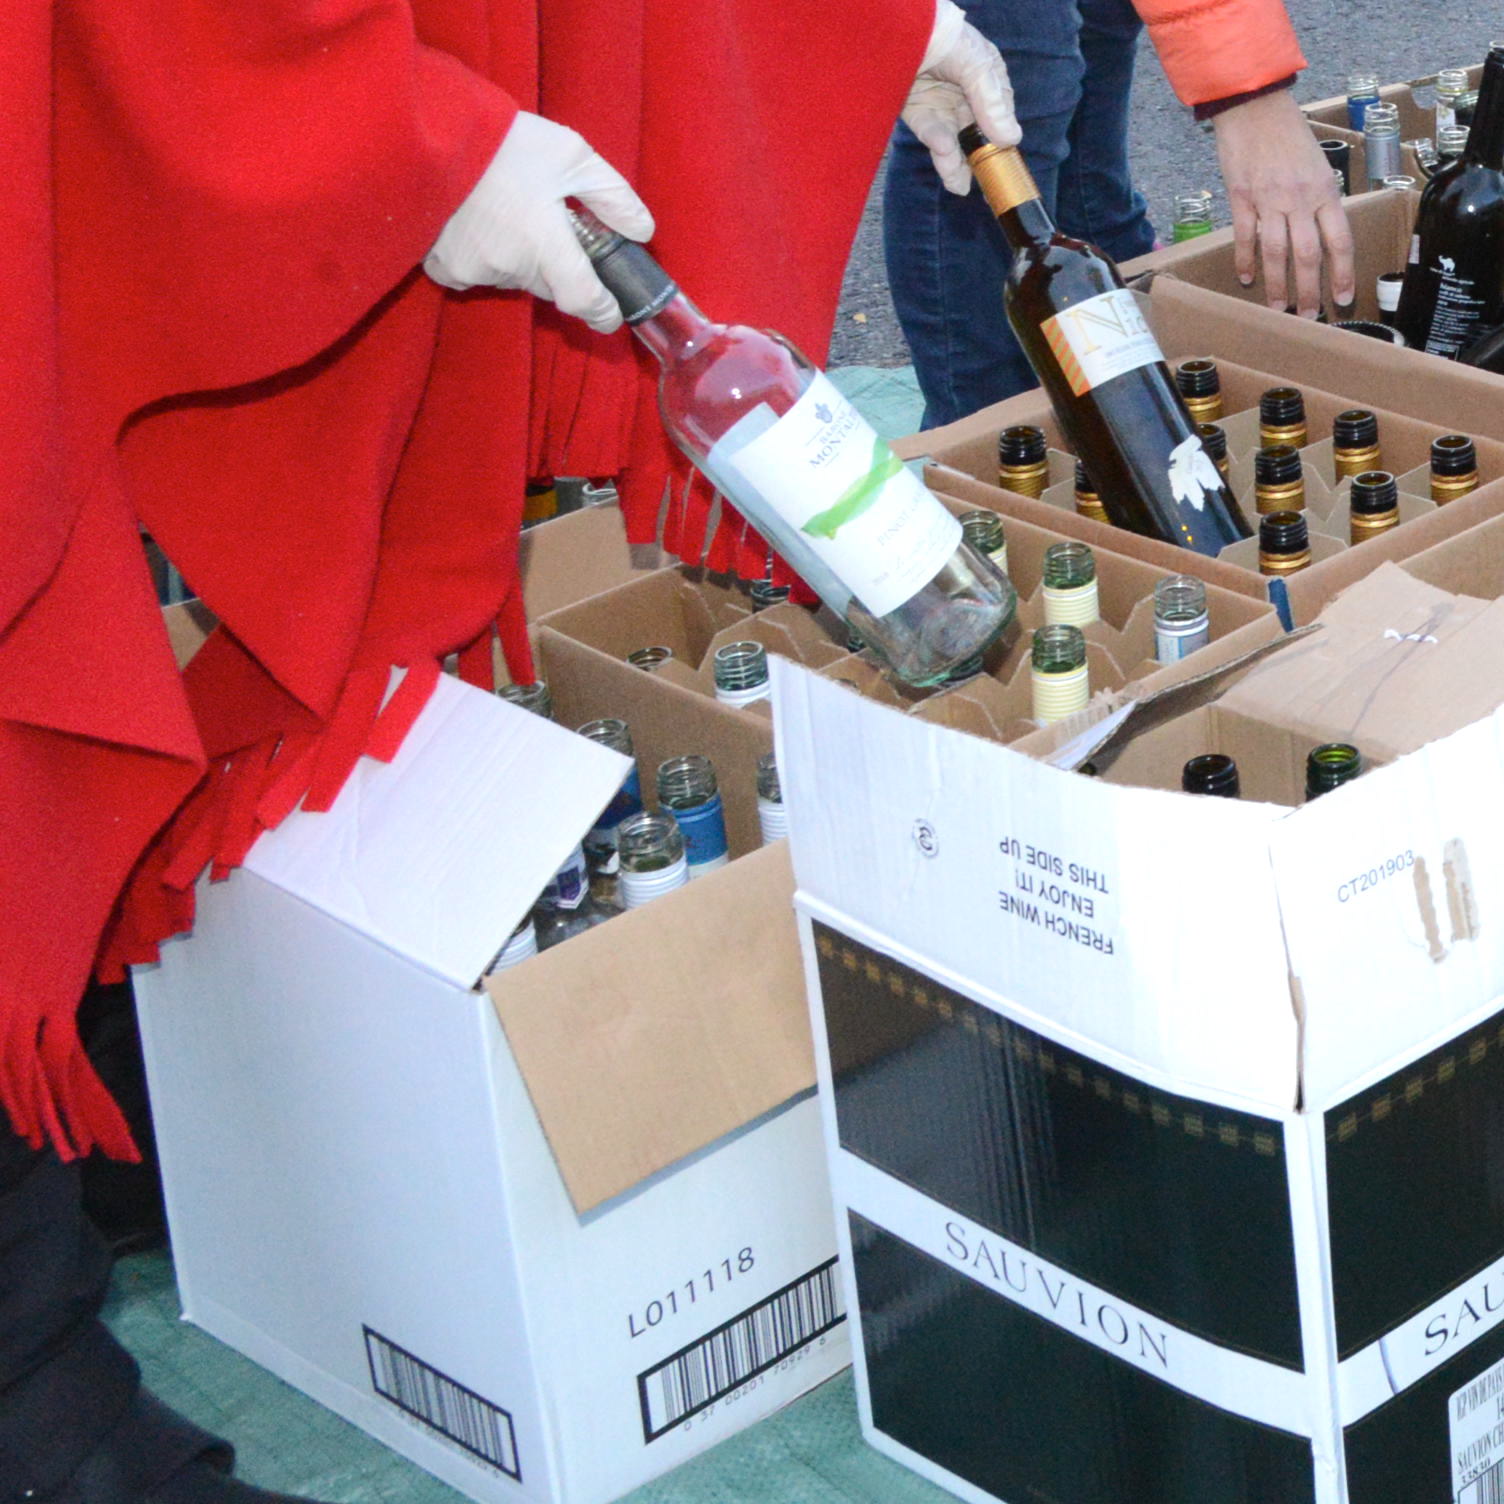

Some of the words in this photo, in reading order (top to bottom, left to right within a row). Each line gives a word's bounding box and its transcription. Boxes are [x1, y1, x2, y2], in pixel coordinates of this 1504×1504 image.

[999, 836, 1022, 857] UP
[1025, 844, 1064, 877] SIDE
[1014, 869, 1034, 893] IT!
[1069, 861, 1109, 894] THIS
[1336, 848, 1416, 904] CT201903
[999, 890, 1042, 929] WINE
[1038, 881, 1094, 917] ENJOY
[1046, 912, 1114, 956] FRENCH
[945, 1220, 1169, 1370] SAUVION
[1456, 1431, 1492, 1476] SAUVION
